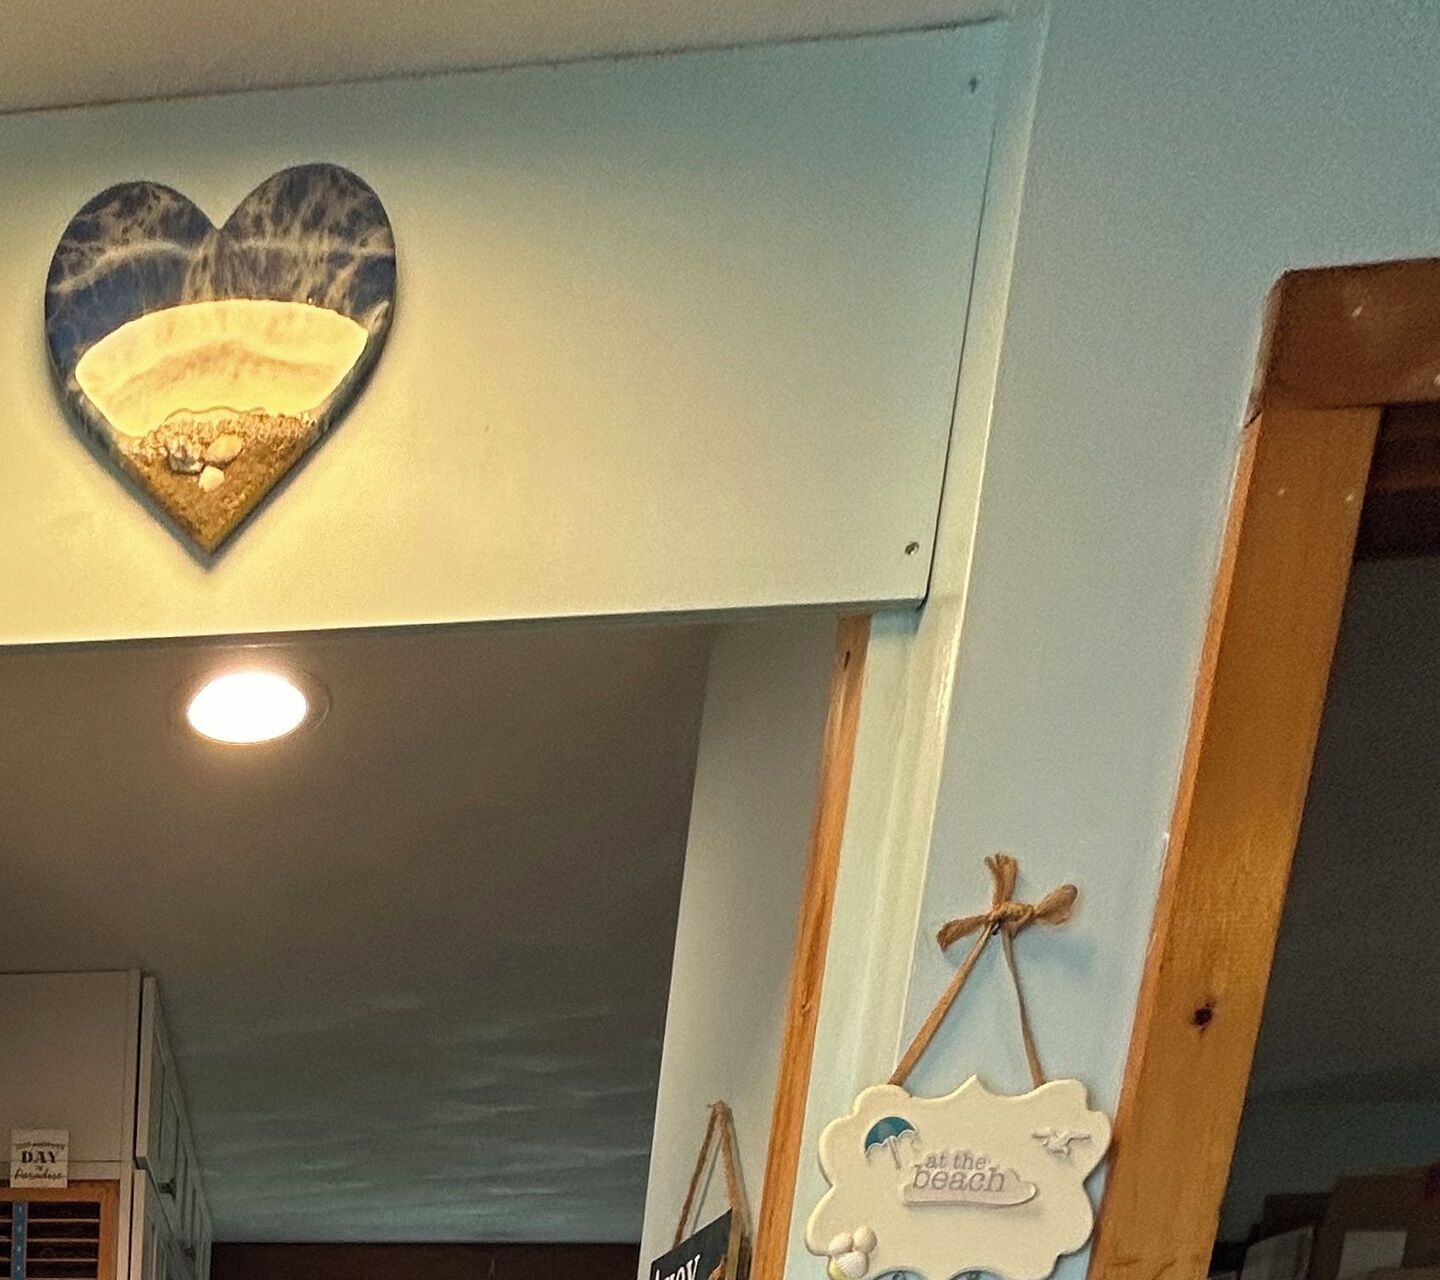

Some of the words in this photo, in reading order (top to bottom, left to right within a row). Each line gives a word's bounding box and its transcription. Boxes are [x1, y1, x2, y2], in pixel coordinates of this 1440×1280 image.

[21, 1150, 56, 1164] DAY
[925, 1154, 946, 1169] at
[953, 1151, 987, 1170] the
[912, 1164, 1006, 1193] beach
